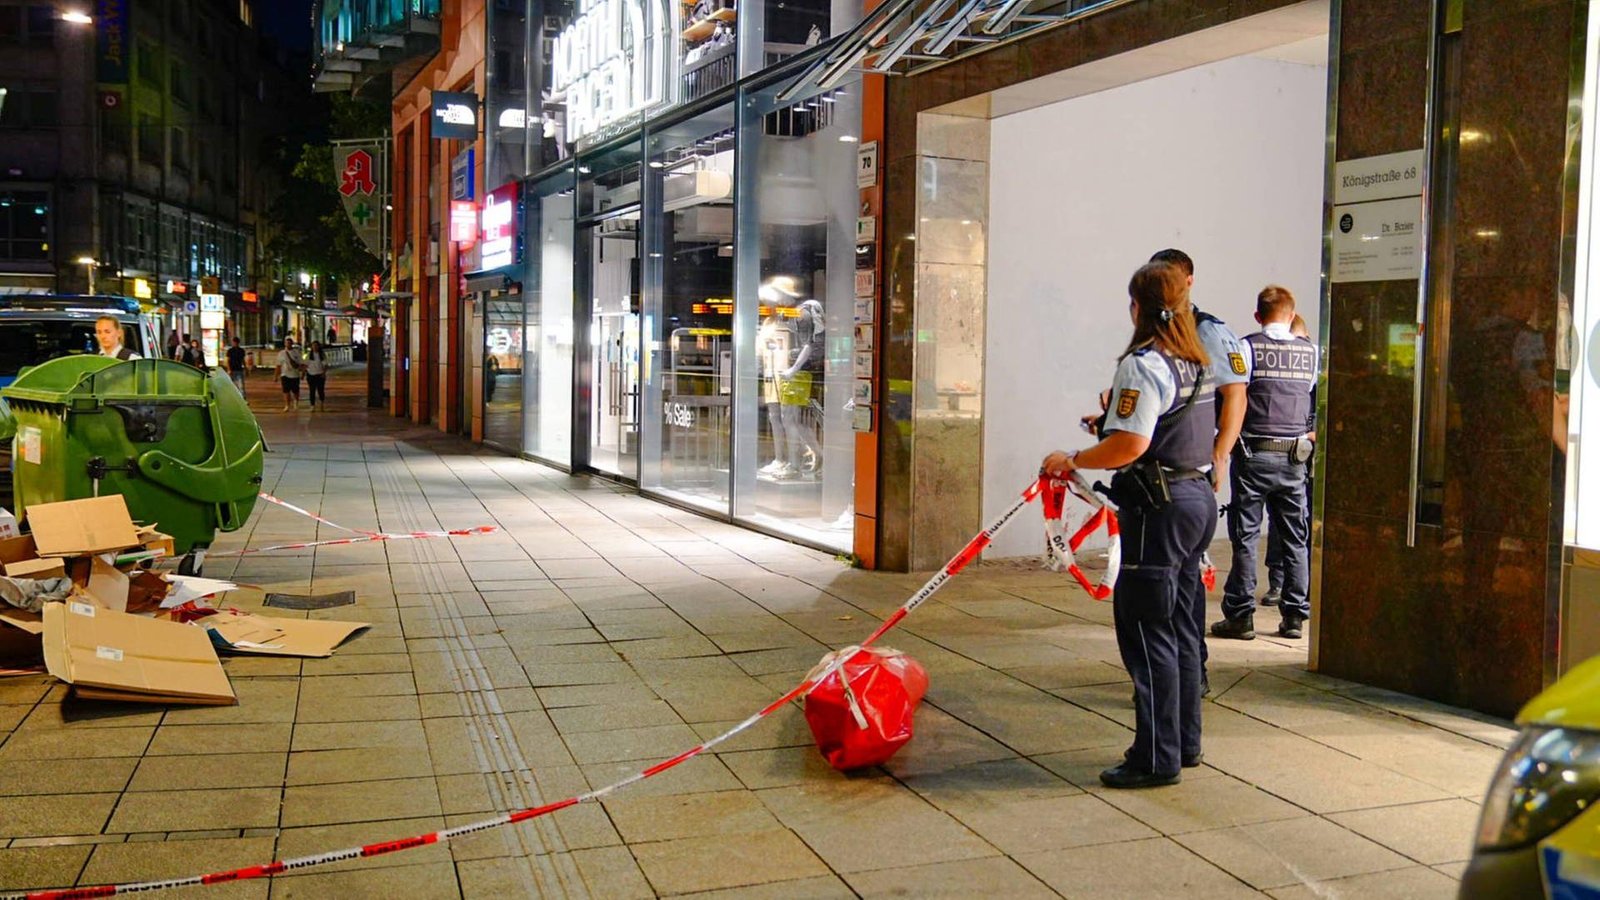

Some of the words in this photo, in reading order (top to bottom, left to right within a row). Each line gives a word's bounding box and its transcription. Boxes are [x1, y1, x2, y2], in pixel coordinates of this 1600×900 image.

[862, 156, 872, 169] 70
[1342, 170, 1401, 188] Königstraße
[1403, 166, 1417, 180] 68
[1254, 351, 1314, 371] POLIZEI
[674, 402, 692, 429] Sale
